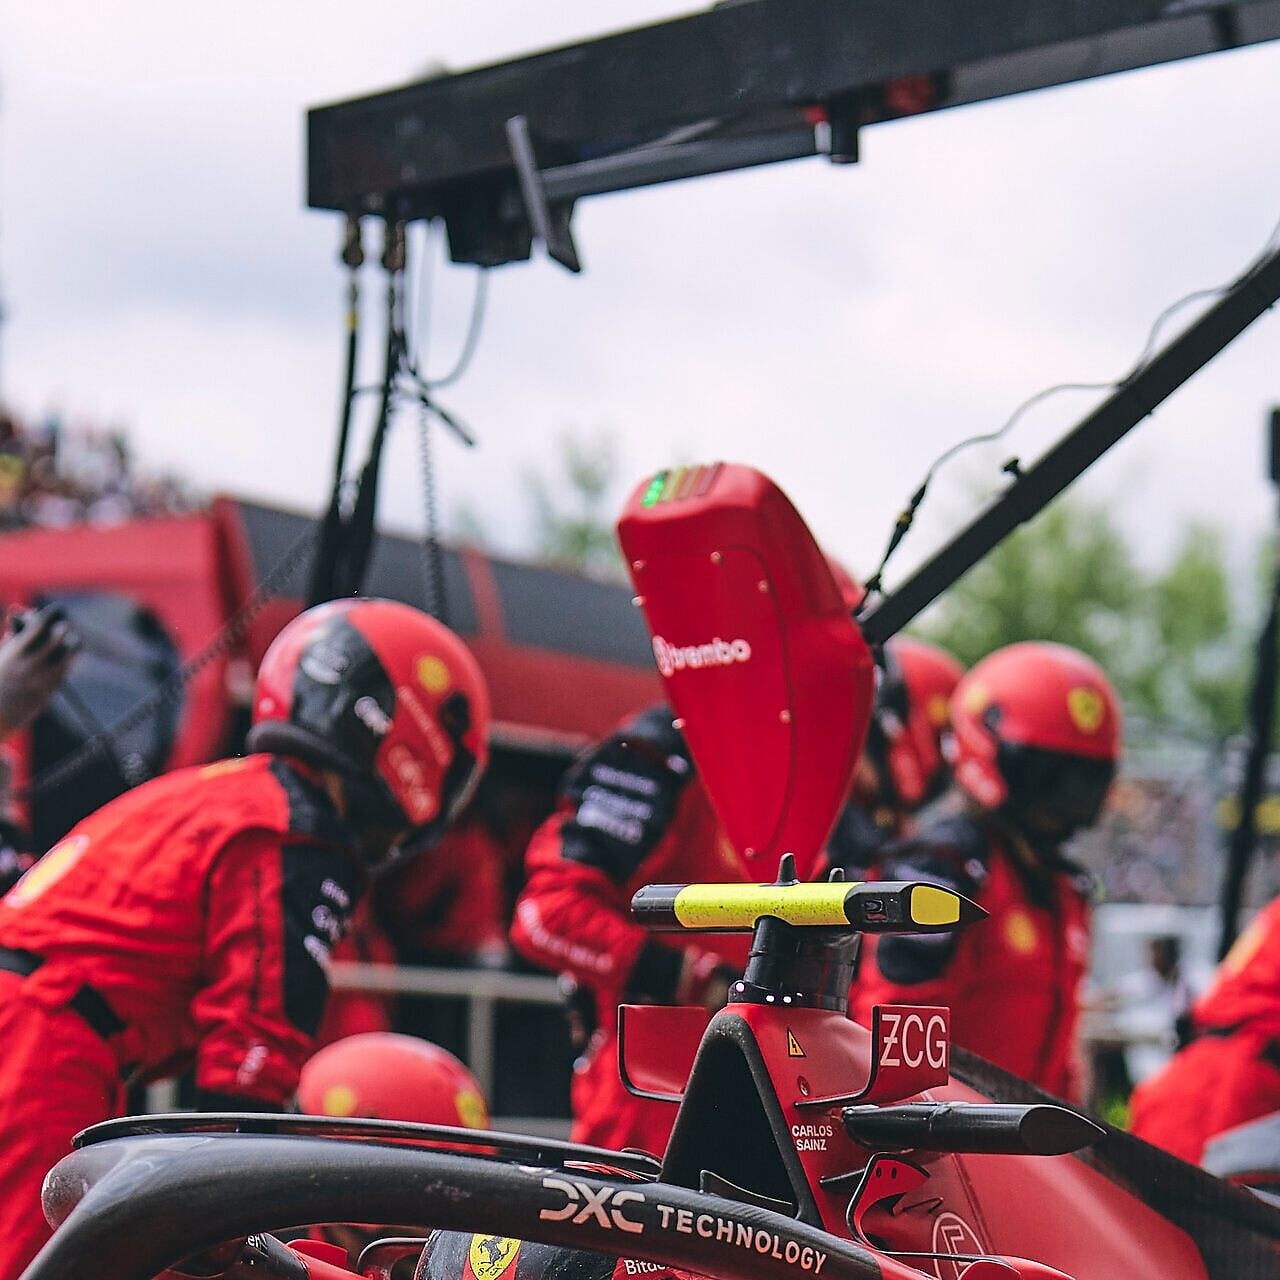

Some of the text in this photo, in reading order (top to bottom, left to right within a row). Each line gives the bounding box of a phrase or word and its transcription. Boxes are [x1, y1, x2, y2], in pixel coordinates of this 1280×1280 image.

[670, 637, 751, 670] brembo
[880, 1014, 946, 1069] ZCG
[792, 1125, 833, 1137] CARLOS
[796, 1139, 827, 1151] SAINZ
[657, 1205, 827, 1274] TECHNOLOGY
